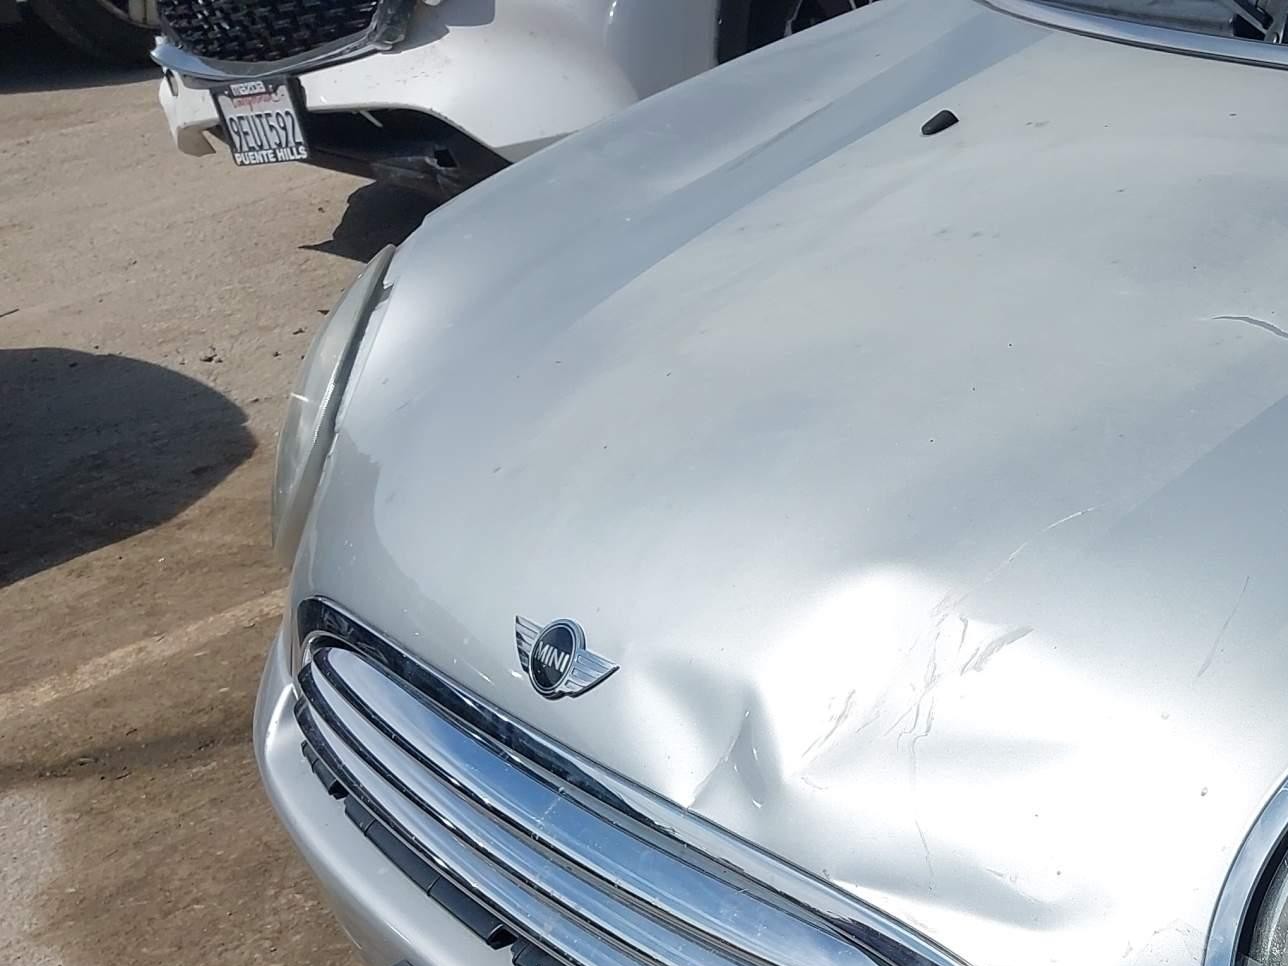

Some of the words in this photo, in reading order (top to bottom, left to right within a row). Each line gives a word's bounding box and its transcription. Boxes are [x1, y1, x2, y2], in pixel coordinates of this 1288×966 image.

[228, 110, 304, 152] 9EUT592
[235, 149, 276, 165] PUENTE
[276, 146, 308, 161] HILLS
[534, 641, 570, 673] MINI
